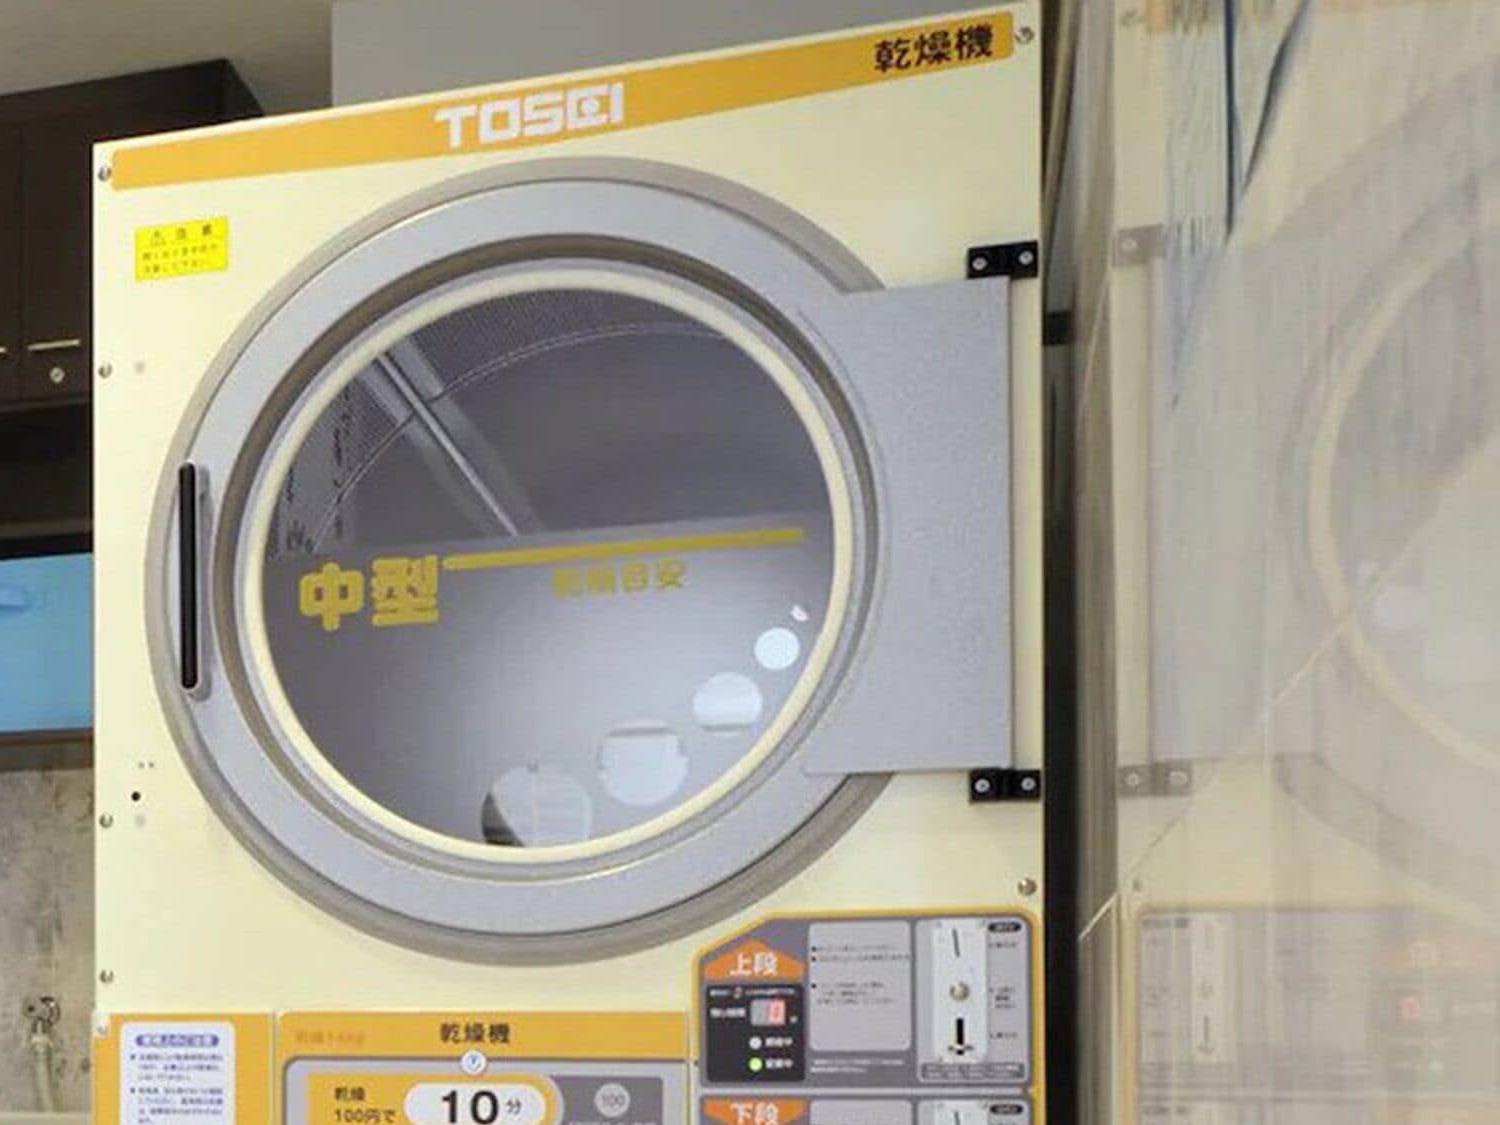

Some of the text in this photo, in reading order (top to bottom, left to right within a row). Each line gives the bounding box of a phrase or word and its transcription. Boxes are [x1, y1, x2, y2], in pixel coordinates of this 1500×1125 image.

[873, 23, 994, 74] 乾燥機
[435, 83, 625, 149] TOSEI
[299, 554, 439, 632] 中型
[729, 952, 778, 976] 上段
[440, 1022, 510, 1044] 乾燥機
[334, 1109, 395, 1124] 100円で
[441, 1089, 522, 1125] 10 分
